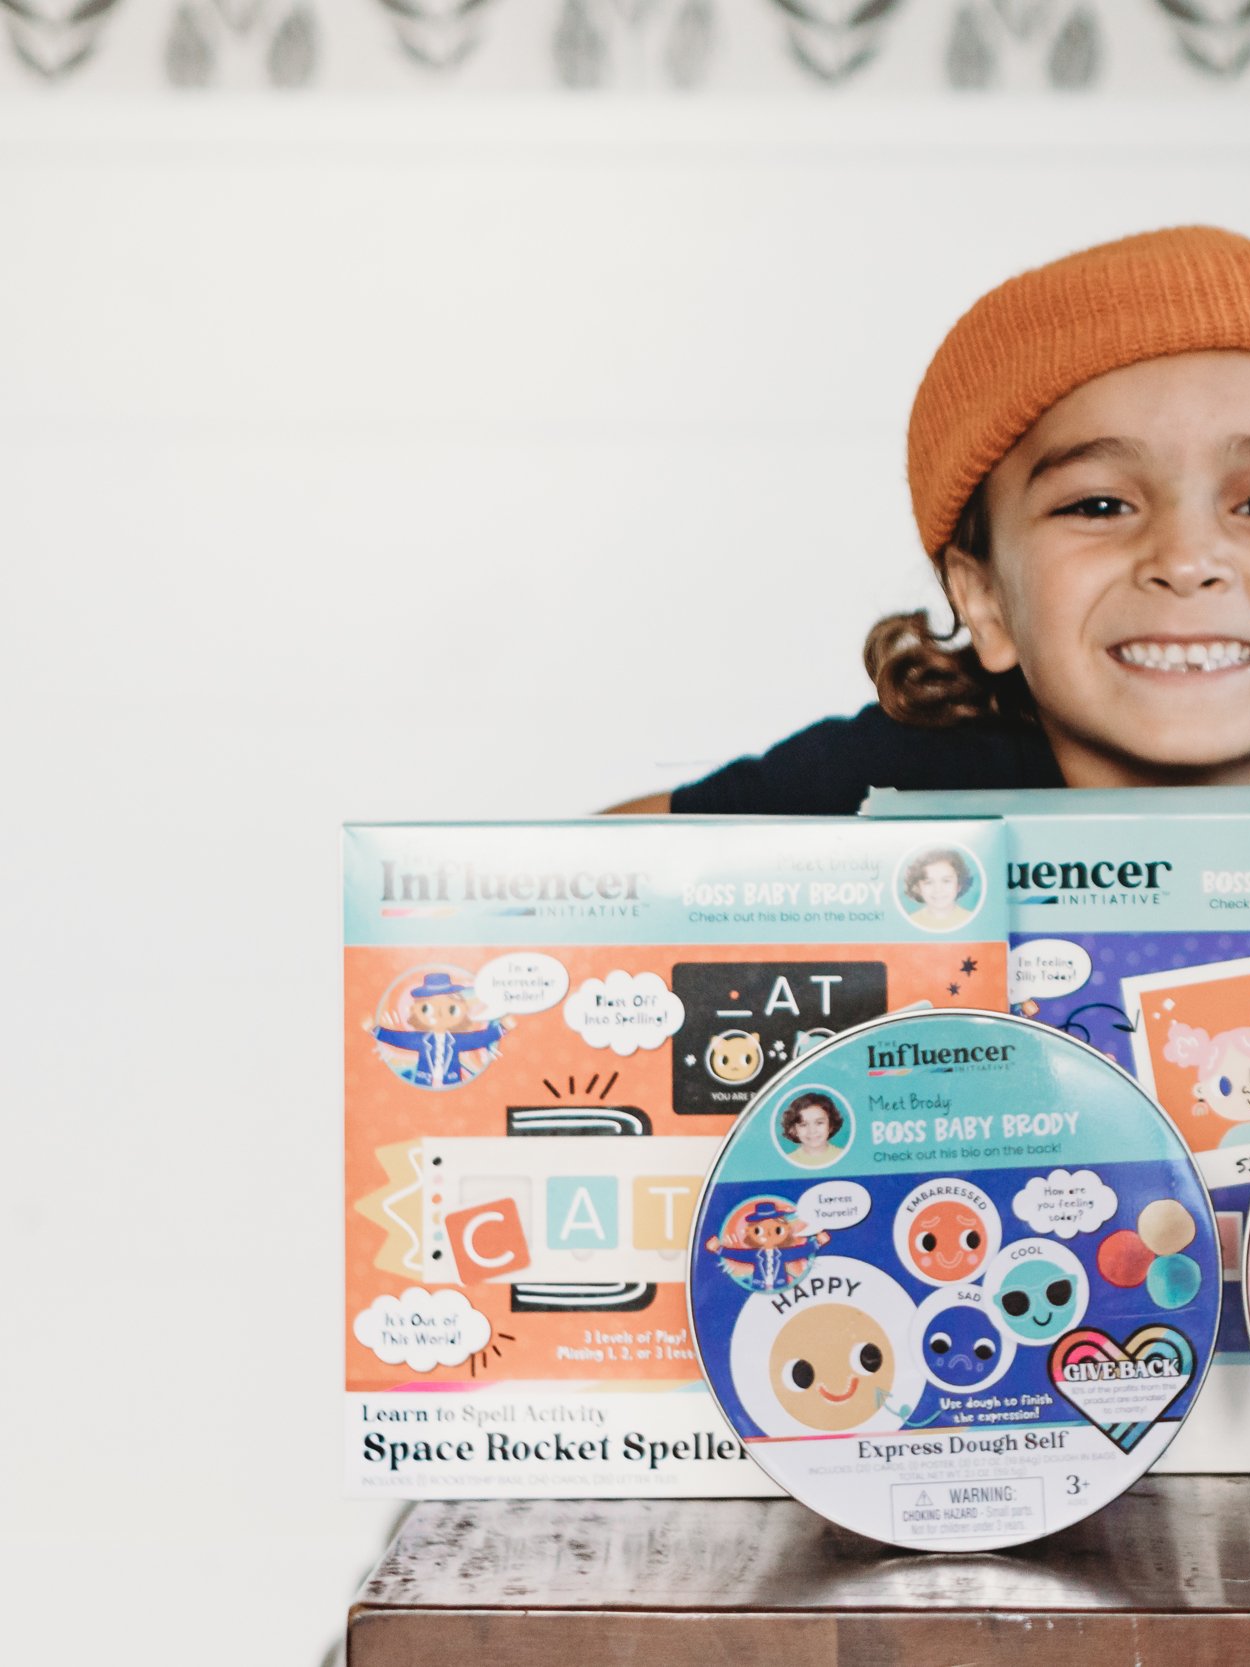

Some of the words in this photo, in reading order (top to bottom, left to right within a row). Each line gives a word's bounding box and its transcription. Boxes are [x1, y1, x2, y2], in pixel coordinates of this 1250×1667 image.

[381, 860, 650, 902] Influencer
[683, 882, 735, 906] BOSS
[745, 882, 800, 906] BABY
[810, 882, 884, 906] BRODY
[1062, 893, 1161, 905] INITIATIVE
[1210, 898, 1250, 910] Check
[689, 911, 729, 923] Check
[735, 912, 754, 922] out
[758, 911, 776, 922] his
[780, 911, 800, 922] bio
[805, 914, 820, 922] on
[824, 911, 844, 922] the
[848, 911, 885, 922] back!
[867, 1041, 1016, 1070] Influencer
[869, 1094, 903, 1112] Meet
[871, 1119, 928, 1146] BOSS
[934, 1115, 994, 1143] BABY
[1002, 1112, 1080, 1139] BRODY
[873, 1149, 913, 1164] Check
[915, 1151, 937, 1162] out
[940, 1149, 958, 1160] his
[961, 1147, 982, 1159] bio
[984, 1149, 1001, 1158] on
[1003, 1146, 1024, 1157] the
[1027, 1143, 1062, 1156] back!
[905, 1185, 988, 1213] EMBARRESSED
[1010, 1246, 1044, 1261] COOL
[771, 1276, 861, 1314] HAPPY
[957, 1291, 981, 1302] SAD
[411, 1312, 437, 1328] Out
[381, 1331, 412, 1346] This
[1063, 1360, 1117, 1382] GIVE
[1116, 1358, 1180, 1381] BACK
[939, 1398, 963, 1410] Use
[966, 1397, 1002, 1411] dough
[1004, 1396, 1018, 1406] to
[1021, 1394, 1053, 1405] finish
[362, 1404, 428, 1423] Learn
[436, 1406, 455, 1422] to
[461, 1405, 516, 1428] Spell
[525, 1404, 607, 1428] Activity
[954, 1412, 976, 1423] the
[978, 1405, 1040, 1422] expression!
[363, 1432, 474, 1470] Space
[487, 1432, 610, 1461] Rocket
[857, 1441, 943, 1462] Express
[949, 1436, 1018, 1456] Dough
[1024, 1430, 1069, 1449] Self
[949, 1486, 1016, 1504] WARNING:
[902, 1509, 942, 1522] CHOKING
[944, 1507, 978, 1520] HAZARD
